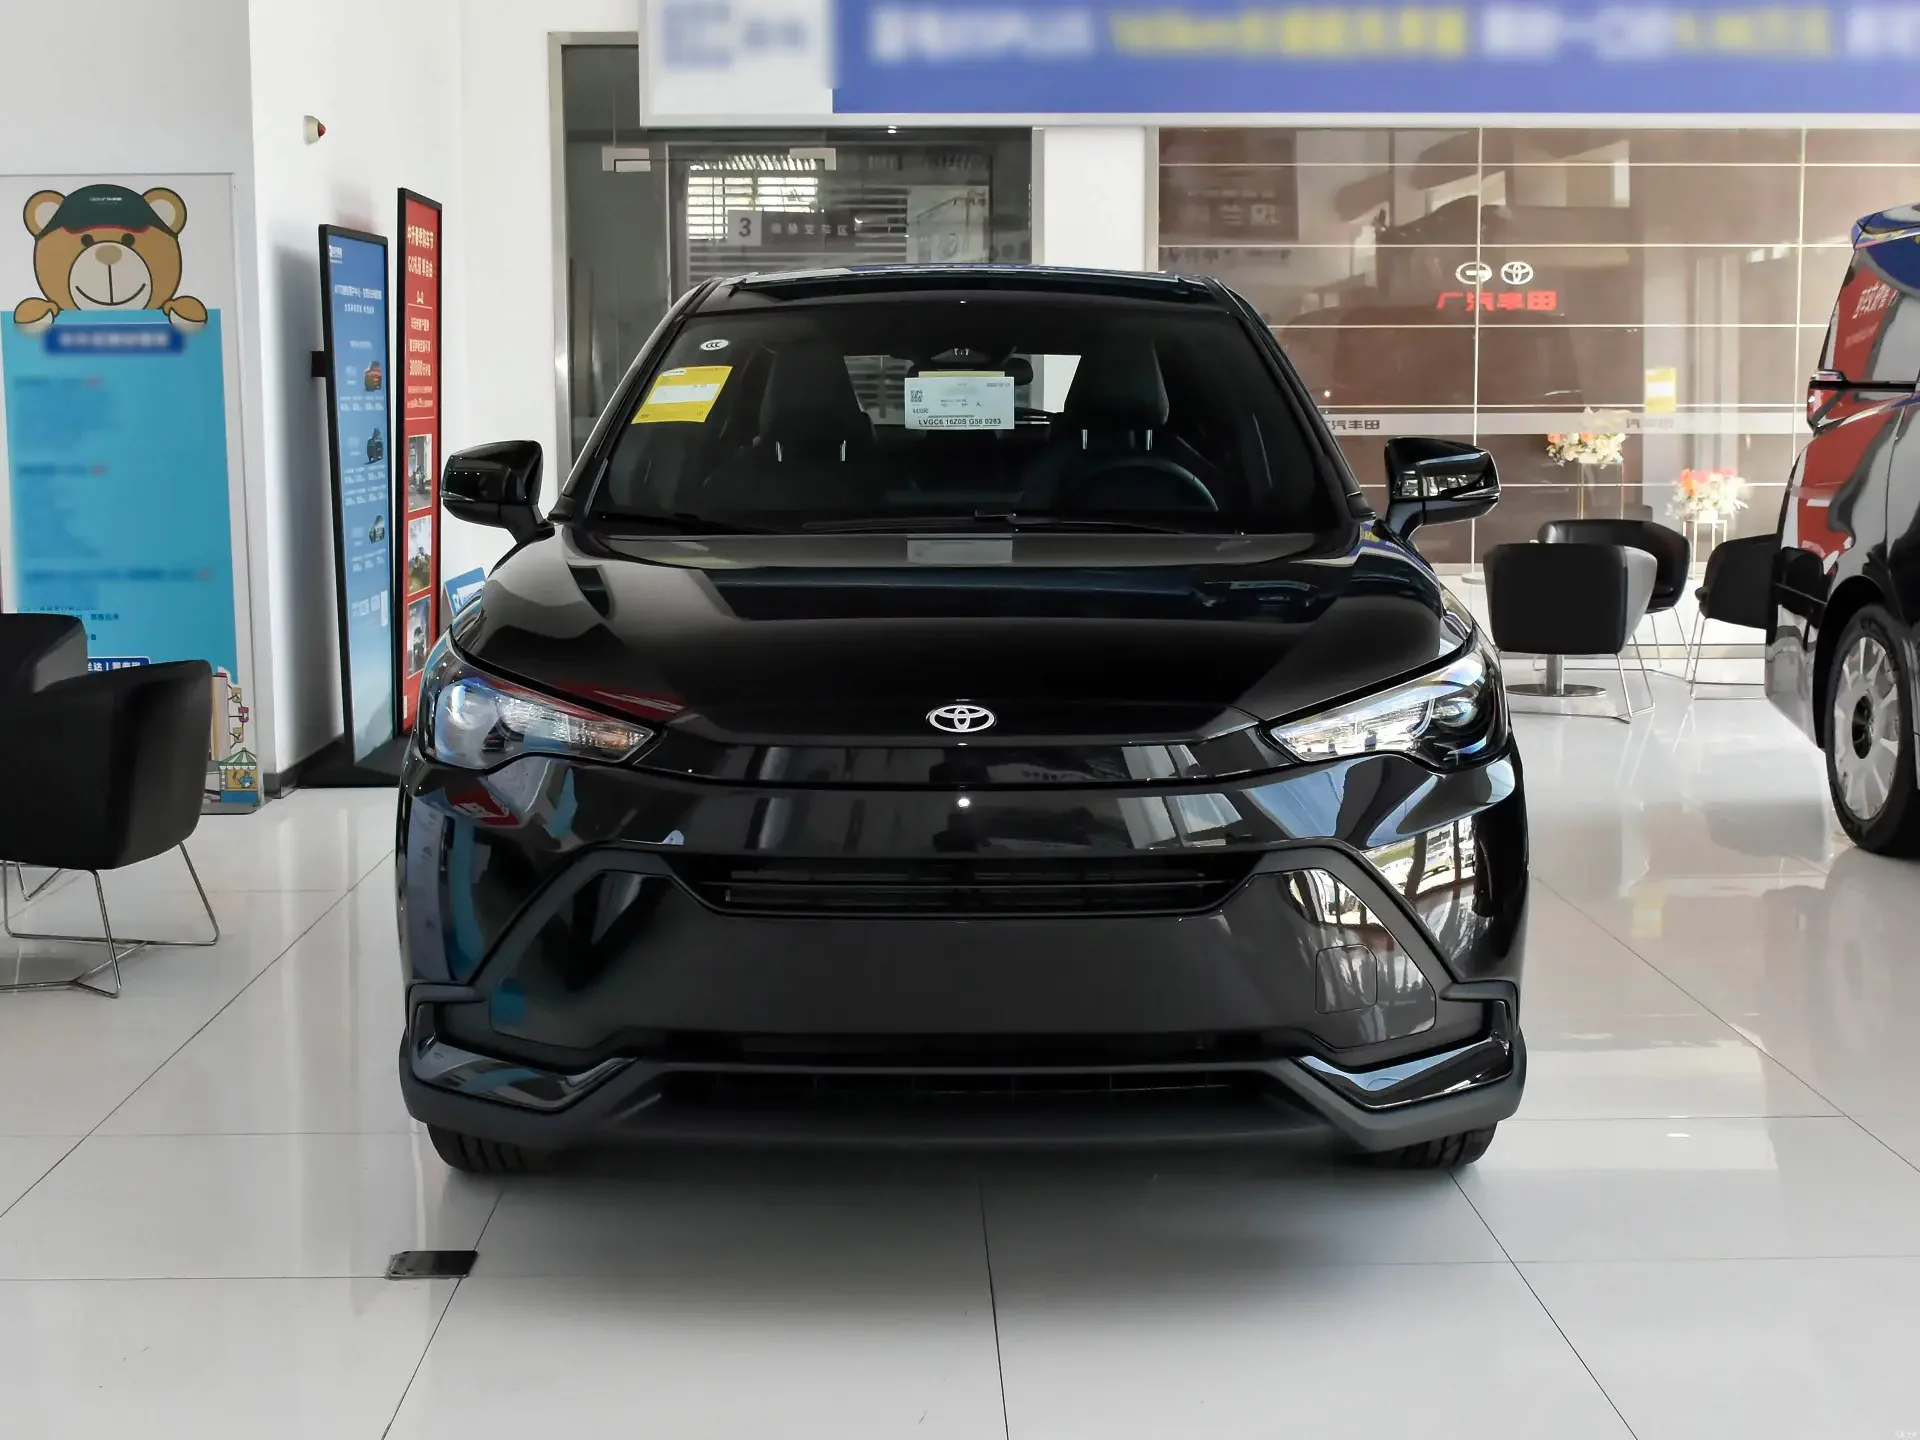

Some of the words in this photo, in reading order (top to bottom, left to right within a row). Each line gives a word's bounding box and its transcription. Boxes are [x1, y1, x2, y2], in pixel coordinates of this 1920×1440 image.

[739, 217, 752, 237] 3
[1436, 290, 1557, 312] 广汽丰田
[1326, 420, 1380, 430] 汽丰田
